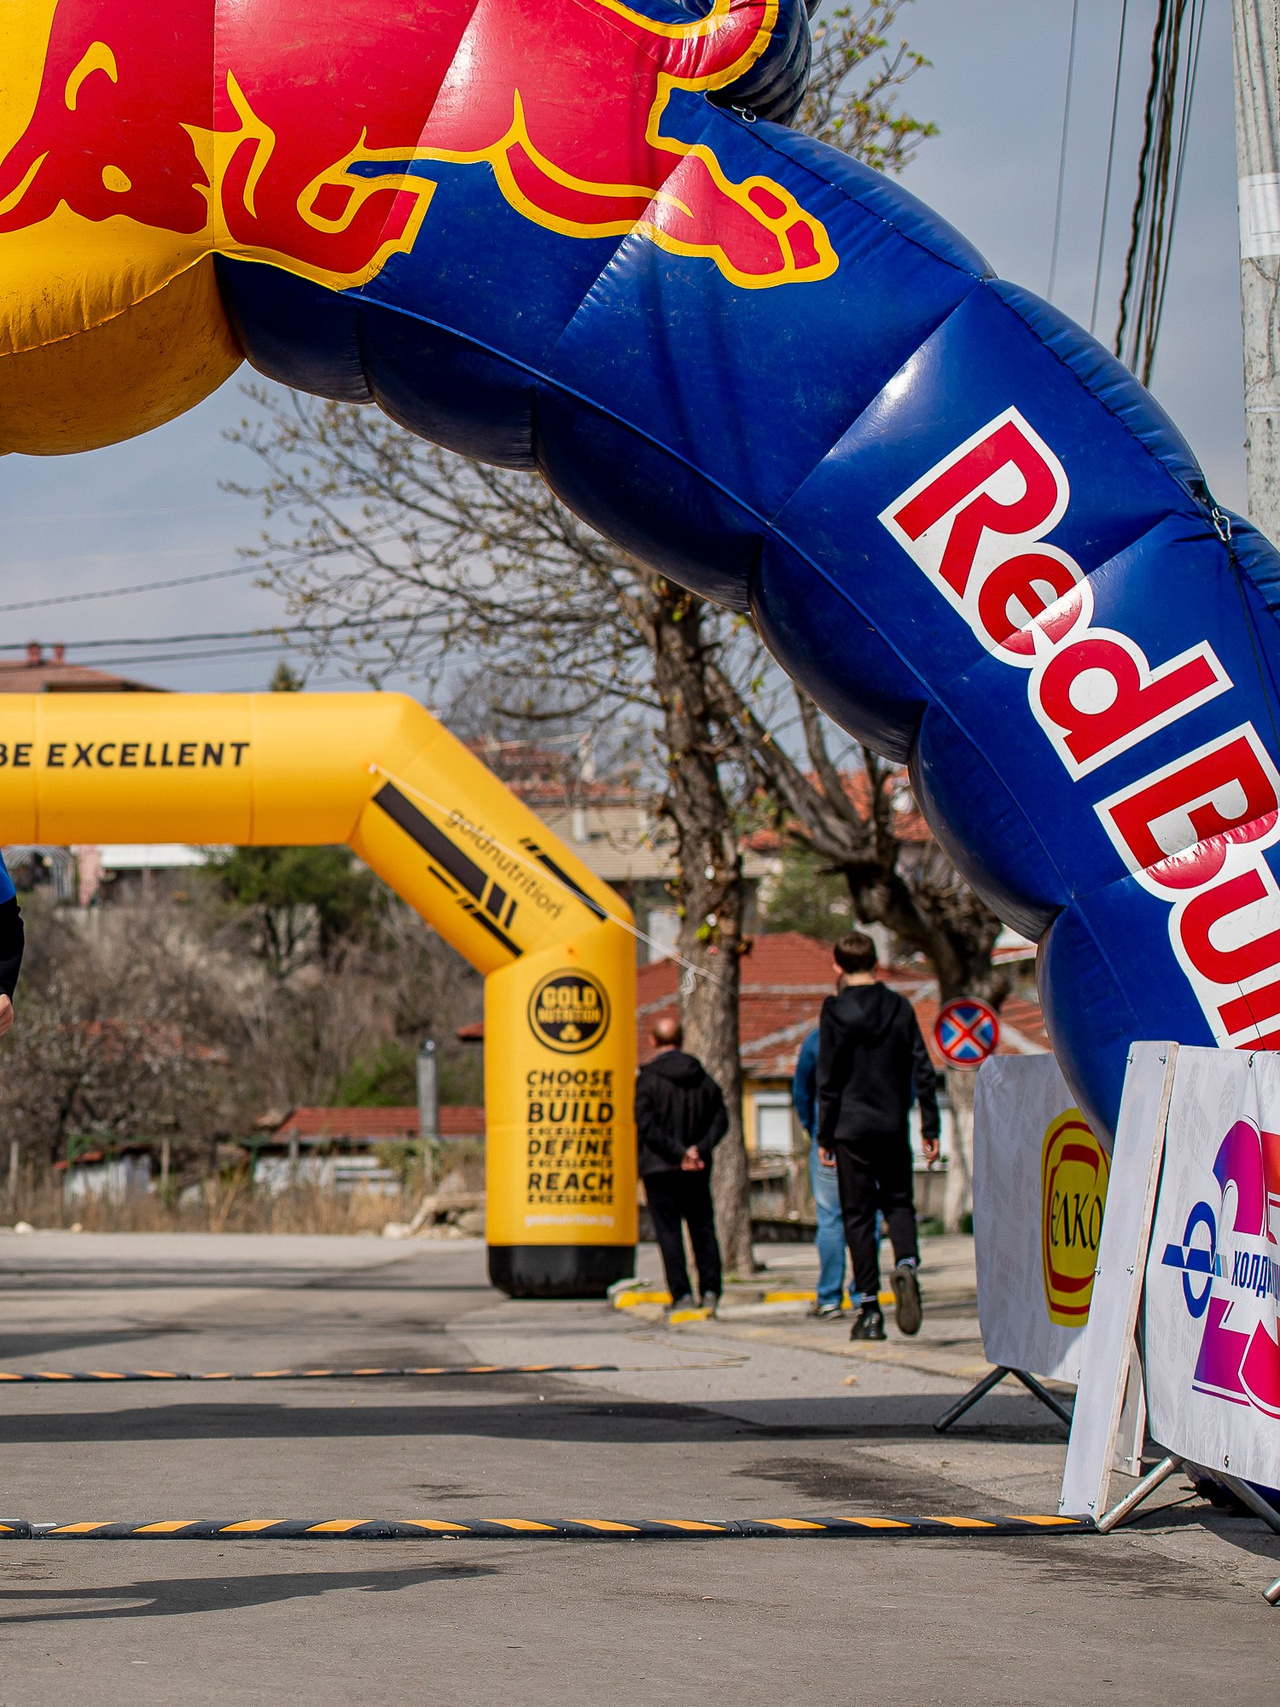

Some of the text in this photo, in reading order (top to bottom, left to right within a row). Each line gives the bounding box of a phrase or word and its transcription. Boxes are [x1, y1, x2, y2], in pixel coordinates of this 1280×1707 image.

[884, 411, 1280, 1049] Red Bu
[47, 743, 250, 767] EXCELLENT
[444, 809, 564, 920] goldnutrition
[541, 986, 598, 1009] GOLD
[527, 1070, 613, 1086] CHOOSE
[528, 1102, 614, 1123] BUILD
[528, 1140, 613, 1155] DEFINE
[528, 1172, 613, 1190] REACH
